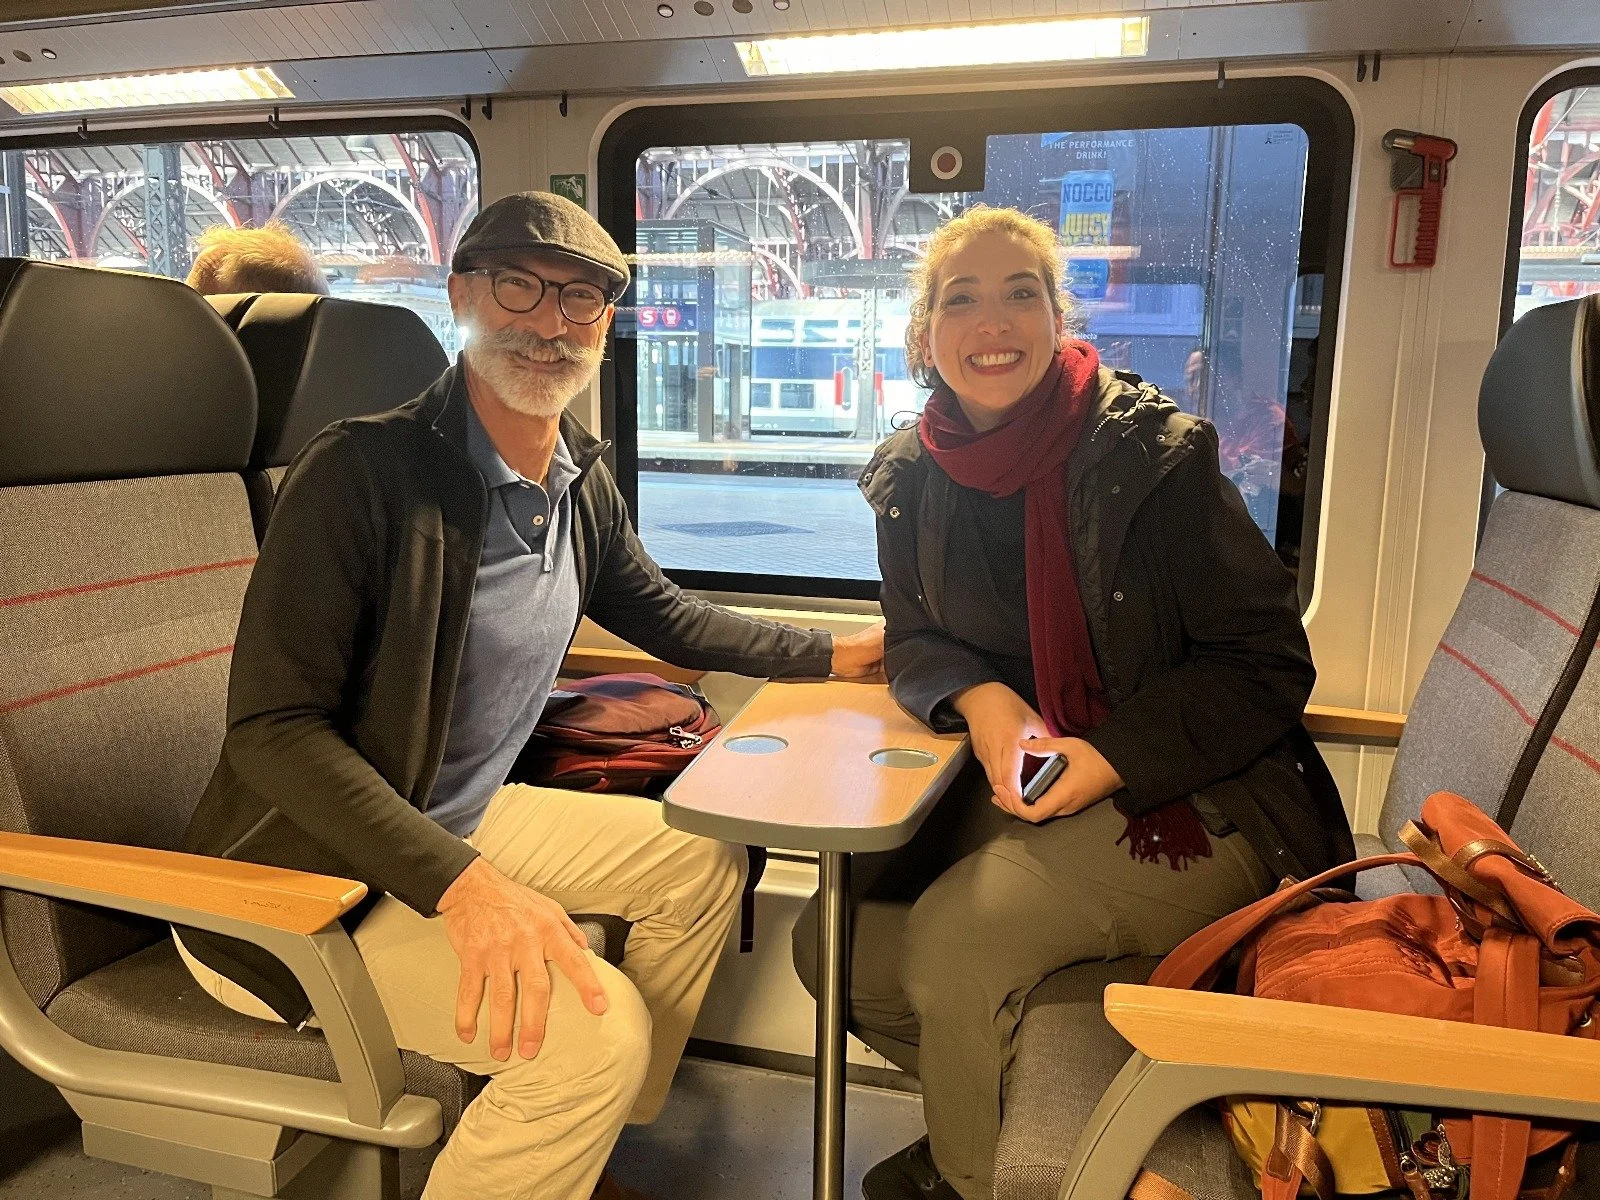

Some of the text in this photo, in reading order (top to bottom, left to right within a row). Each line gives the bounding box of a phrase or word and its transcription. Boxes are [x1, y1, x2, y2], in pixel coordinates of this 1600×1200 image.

[1068, 139, 1134, 149] PERFORMANCE
[1076, 150, 1107, 160] DRINK!
[1063, 182, 1113, 203] NOCCO
[1061, 213, 1108, 236] JUICY
